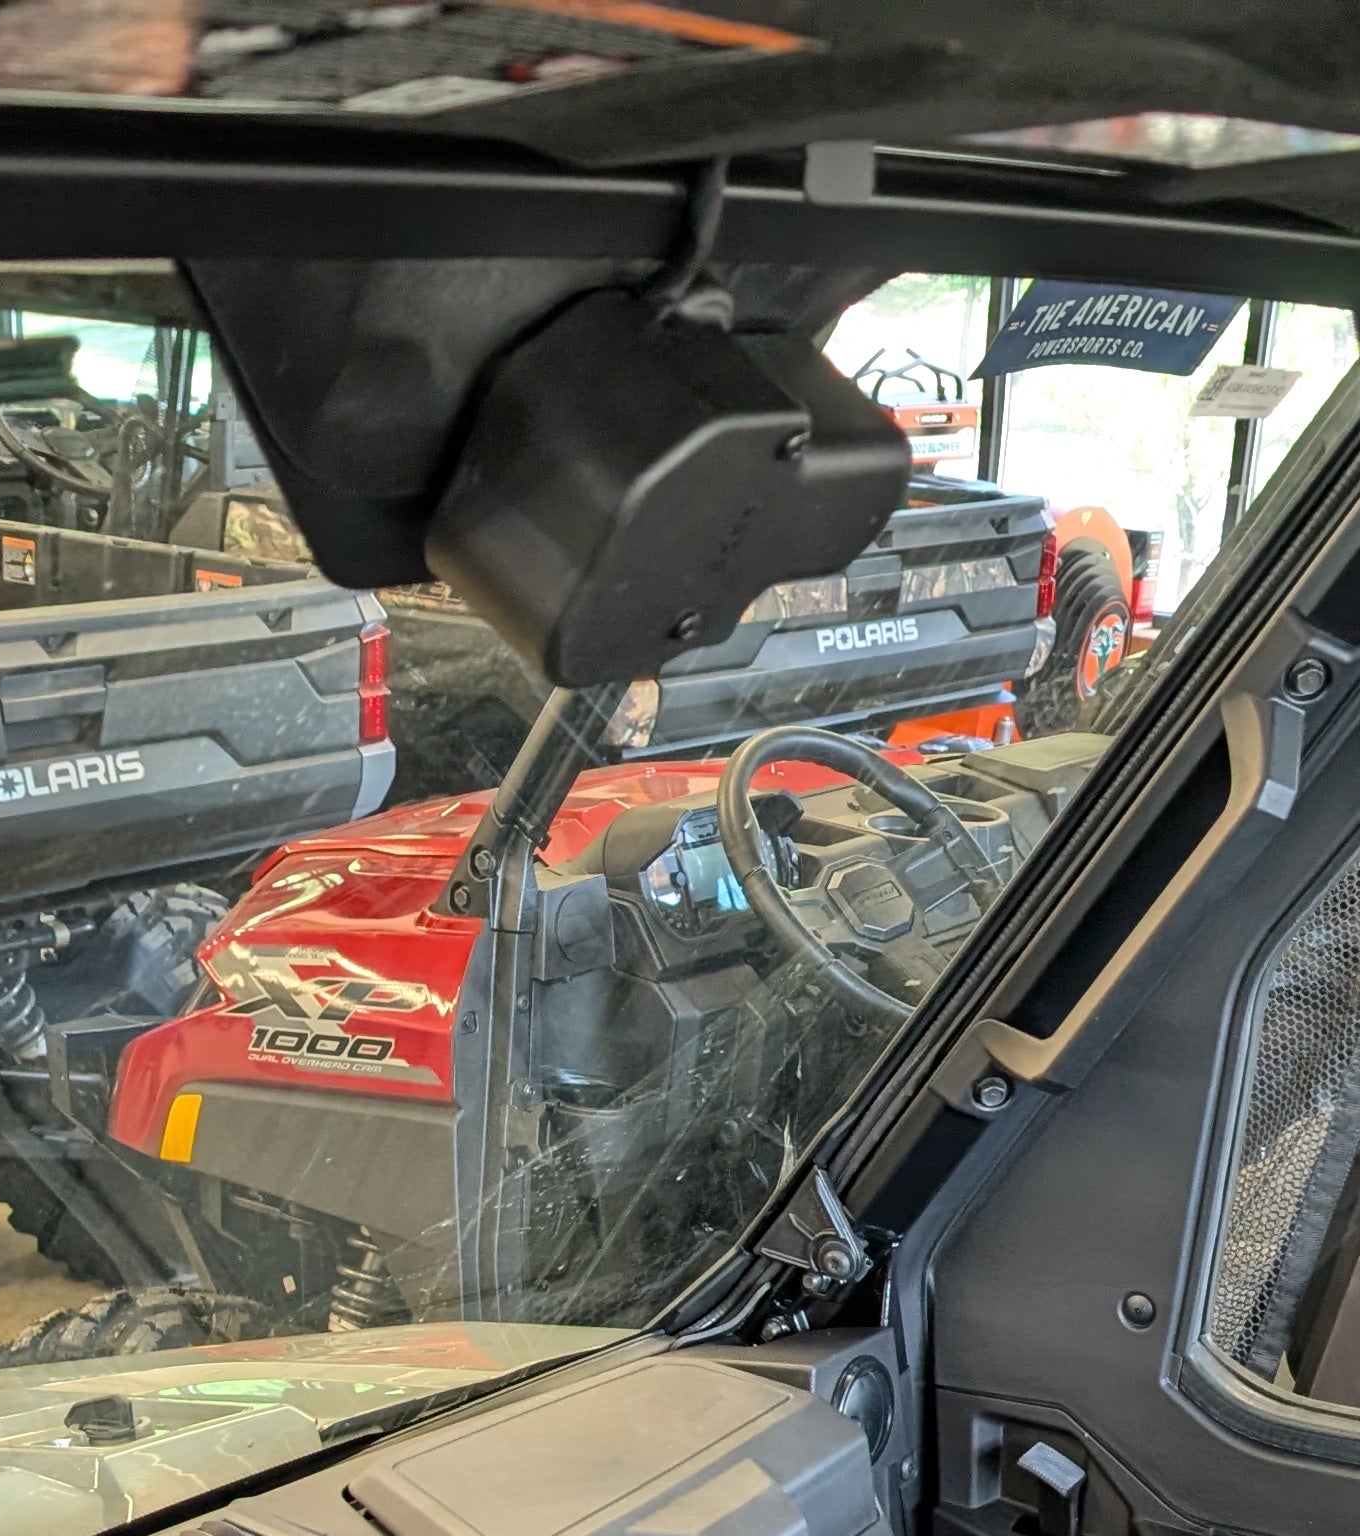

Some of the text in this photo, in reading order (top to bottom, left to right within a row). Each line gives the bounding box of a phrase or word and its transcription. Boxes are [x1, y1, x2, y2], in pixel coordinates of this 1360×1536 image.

[1024, 294, 1205, 337] THE AMERICAN
[1026, 336, 1144, 360] POWERSPORTS CO.
[816, 617, 919, 654] POLARIS
[215, 972, 431, 1025] XP
[248, 1025, 395, 1062] 1000
[247, 1053, 383, 1073] DUAL OVERHEAD CAM
